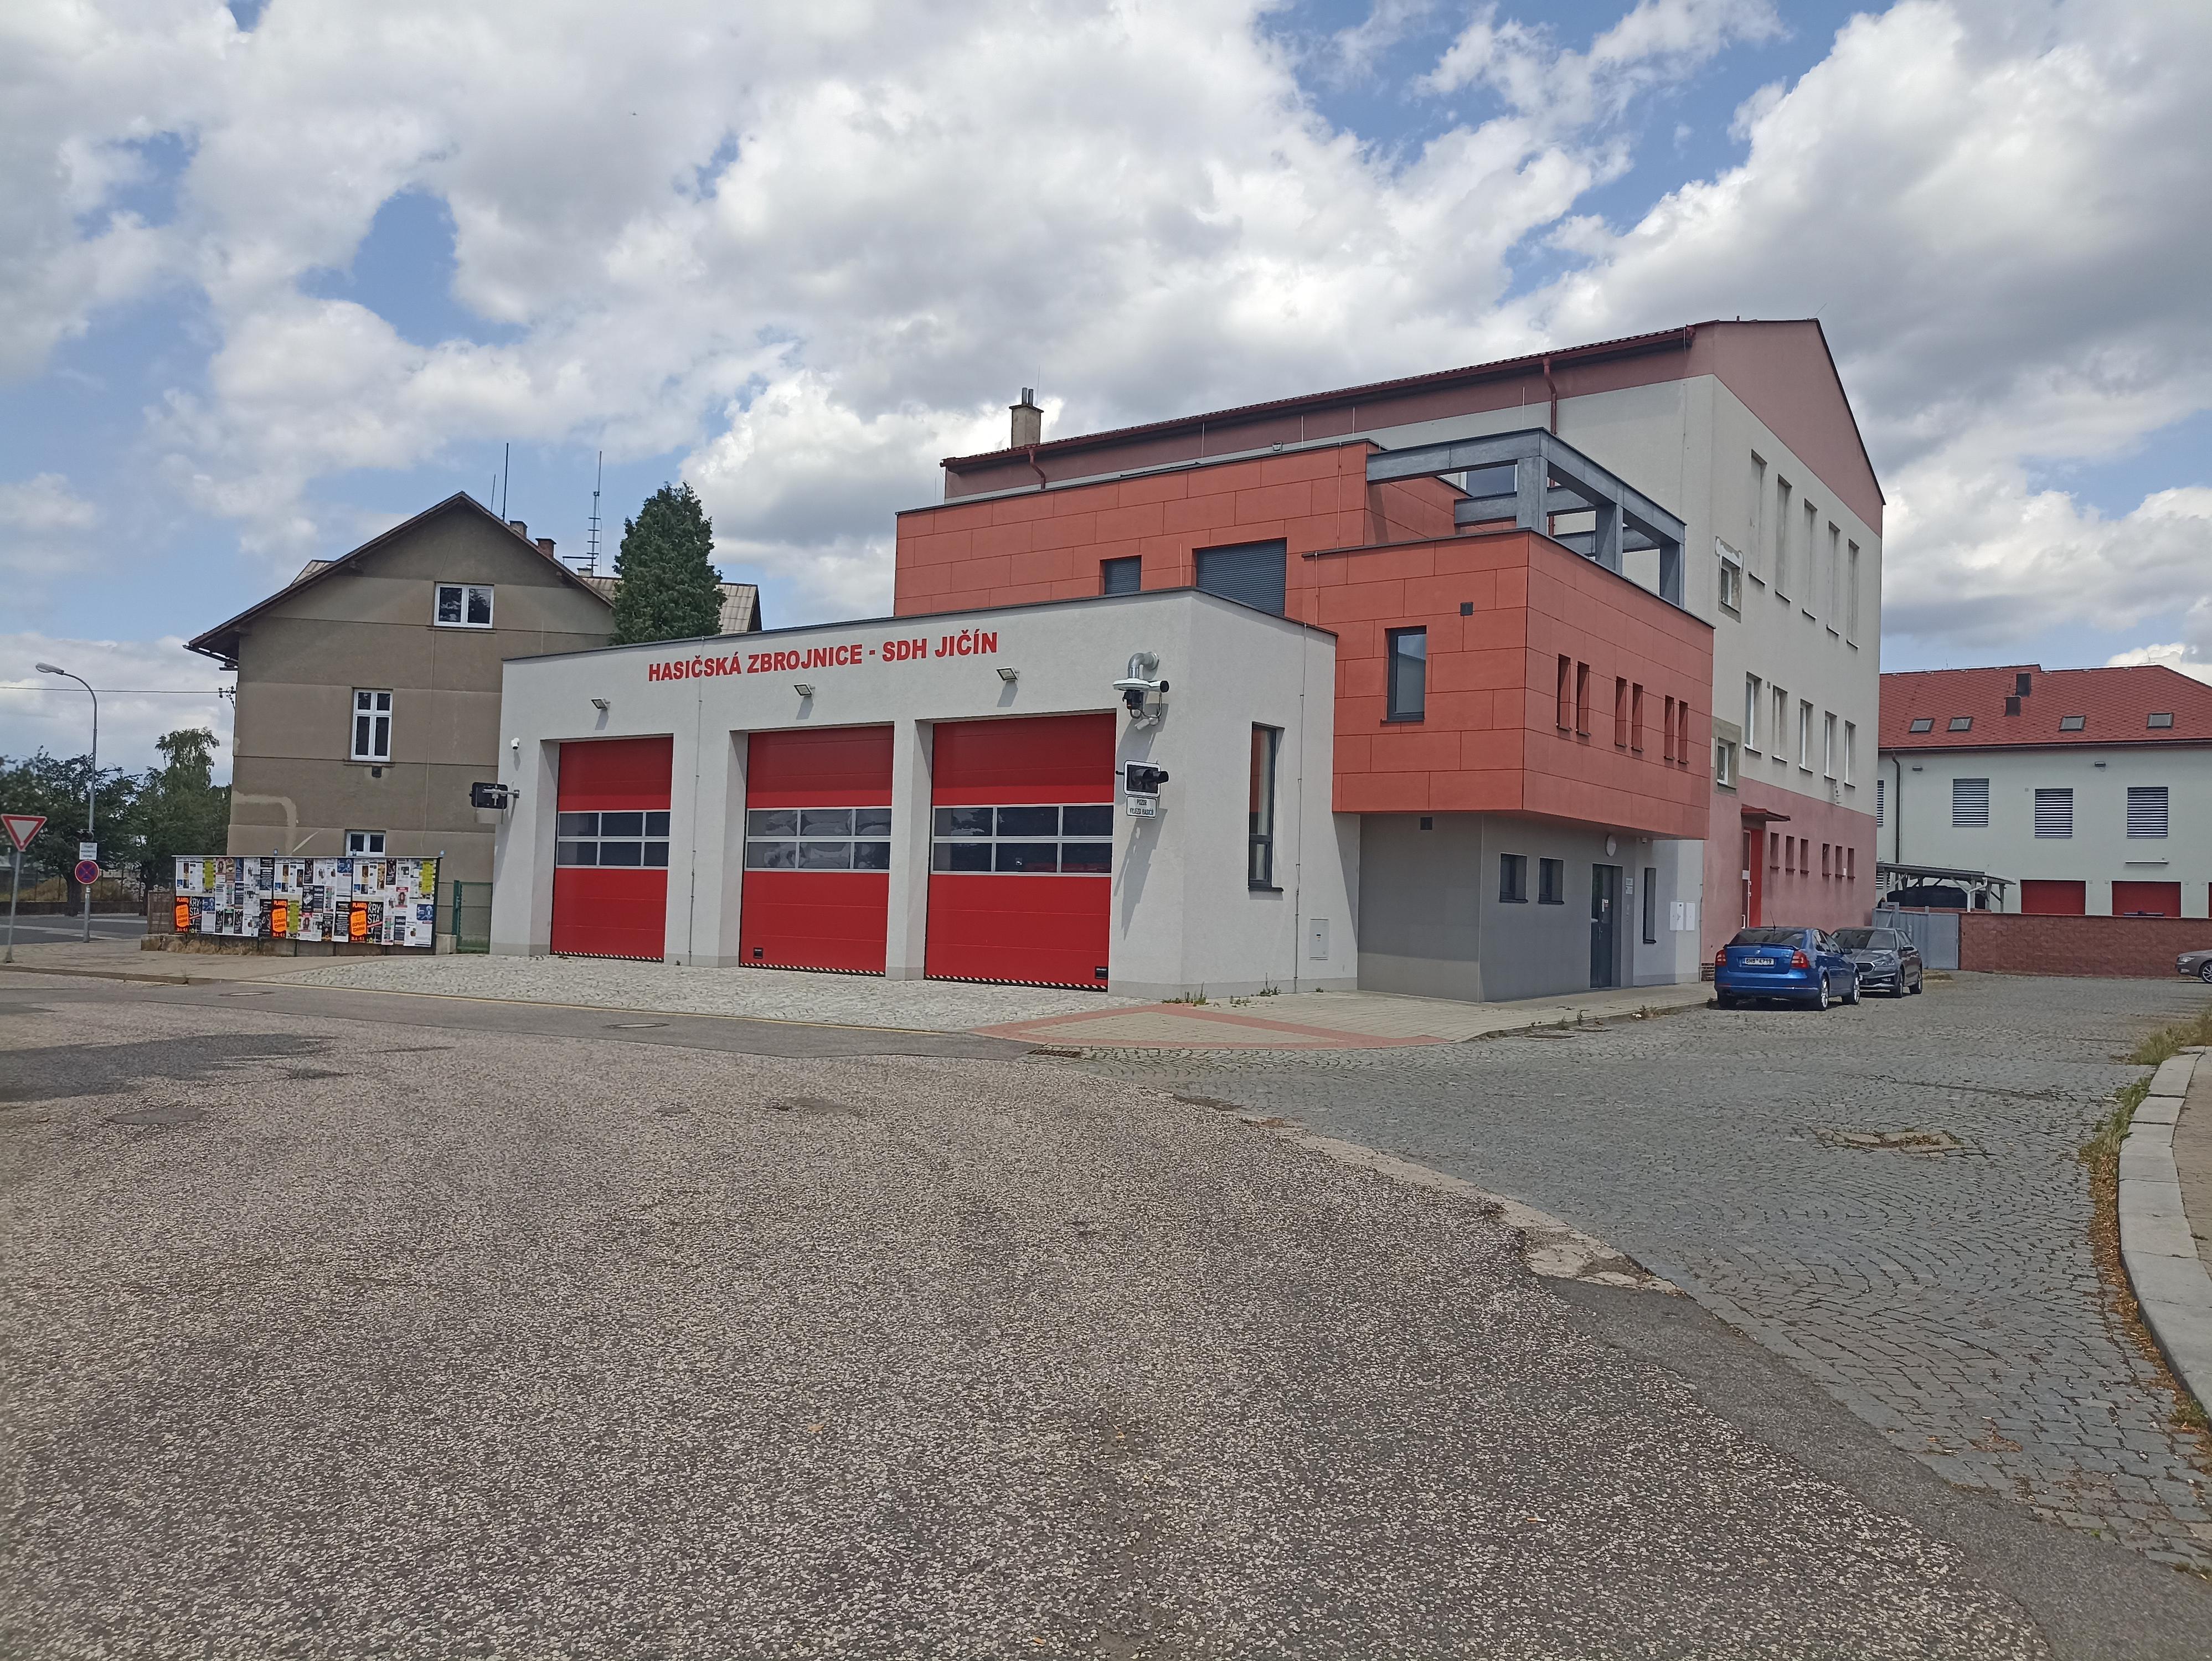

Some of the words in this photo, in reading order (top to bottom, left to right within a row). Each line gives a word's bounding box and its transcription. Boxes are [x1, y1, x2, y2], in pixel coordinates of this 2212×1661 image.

[648, 651, 742, 682] HASIČSKÁ
[747, 644, 863, 674] ZBROJNICE
[882, 638, 927, 662] SDH
[935, 628, 998, 658] JIČÍN
